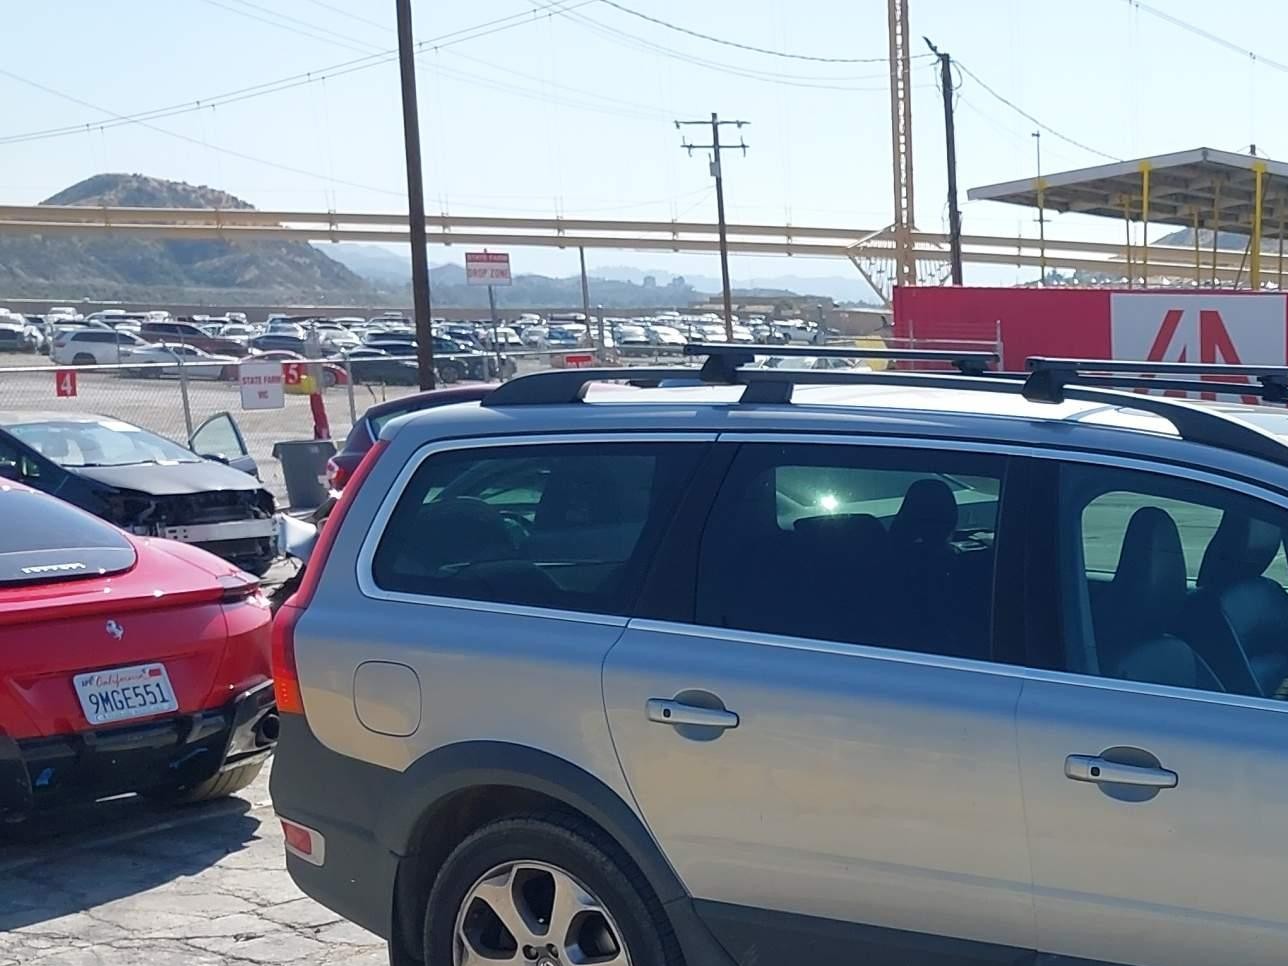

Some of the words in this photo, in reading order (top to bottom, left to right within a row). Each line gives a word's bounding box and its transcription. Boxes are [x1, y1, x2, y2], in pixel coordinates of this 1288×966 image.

[60, 372, 73, 396] 4
[242, 376, 261, 385] STATE
[263, 375, 281, 384] FARM
[287, 363, 299, 384] 5
[88, 682, 169, 714] 9MGE551
